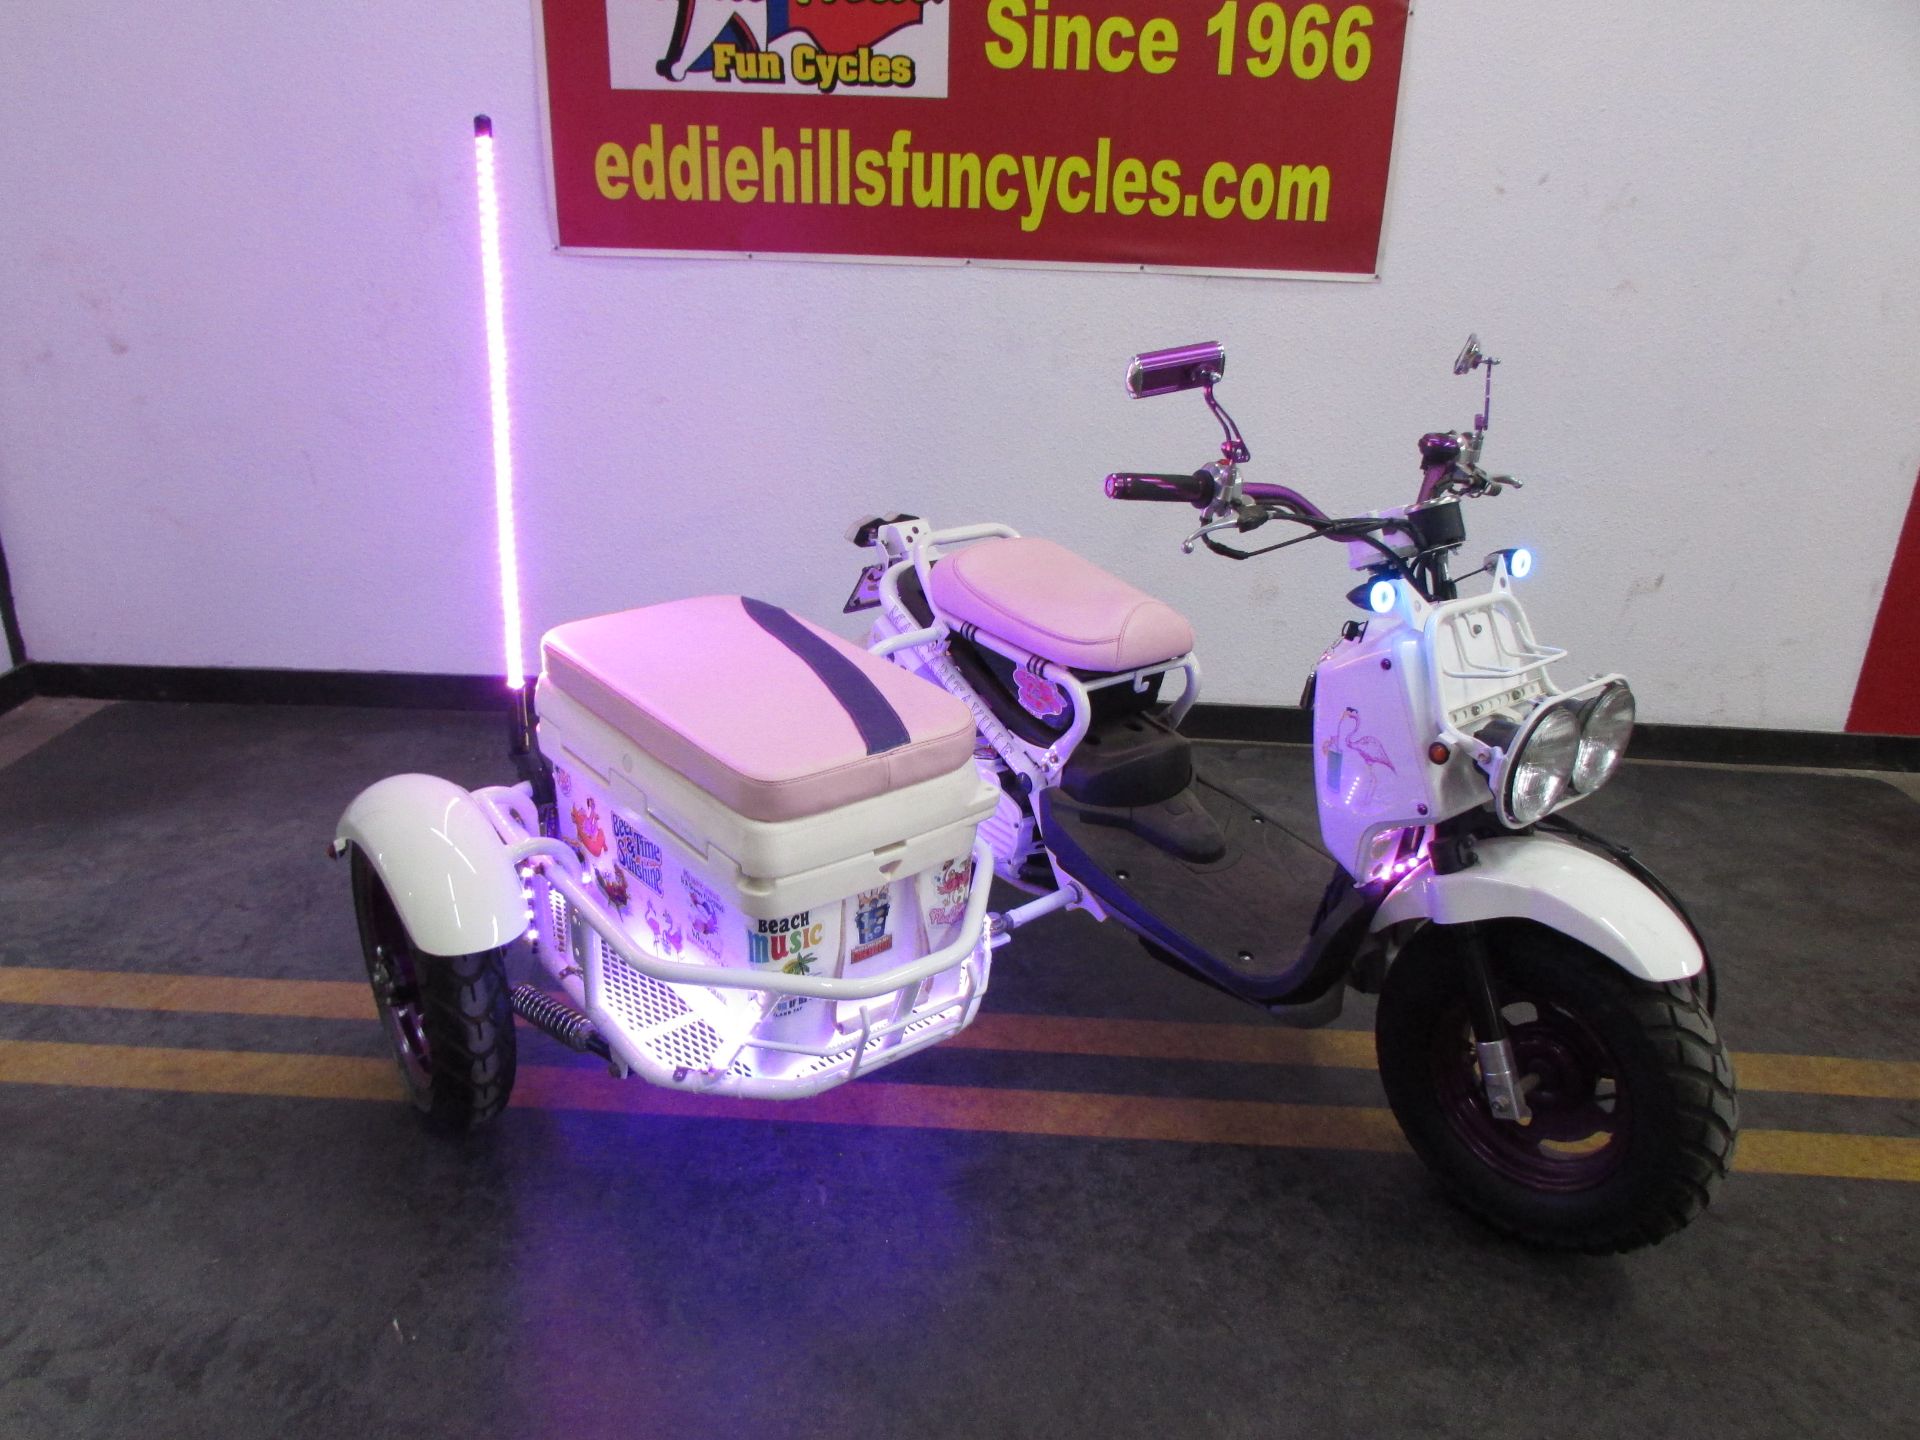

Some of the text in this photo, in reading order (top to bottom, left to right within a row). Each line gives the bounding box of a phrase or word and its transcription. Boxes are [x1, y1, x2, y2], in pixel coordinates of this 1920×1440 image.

[713, 43, 914, 92] Fun Cycles
[984, 0, 1374, 82] Since 1966
[594, 123, 1331, 232] eddiehillsfuncycles.com
[617, 838, 662, 895] Sunshine
